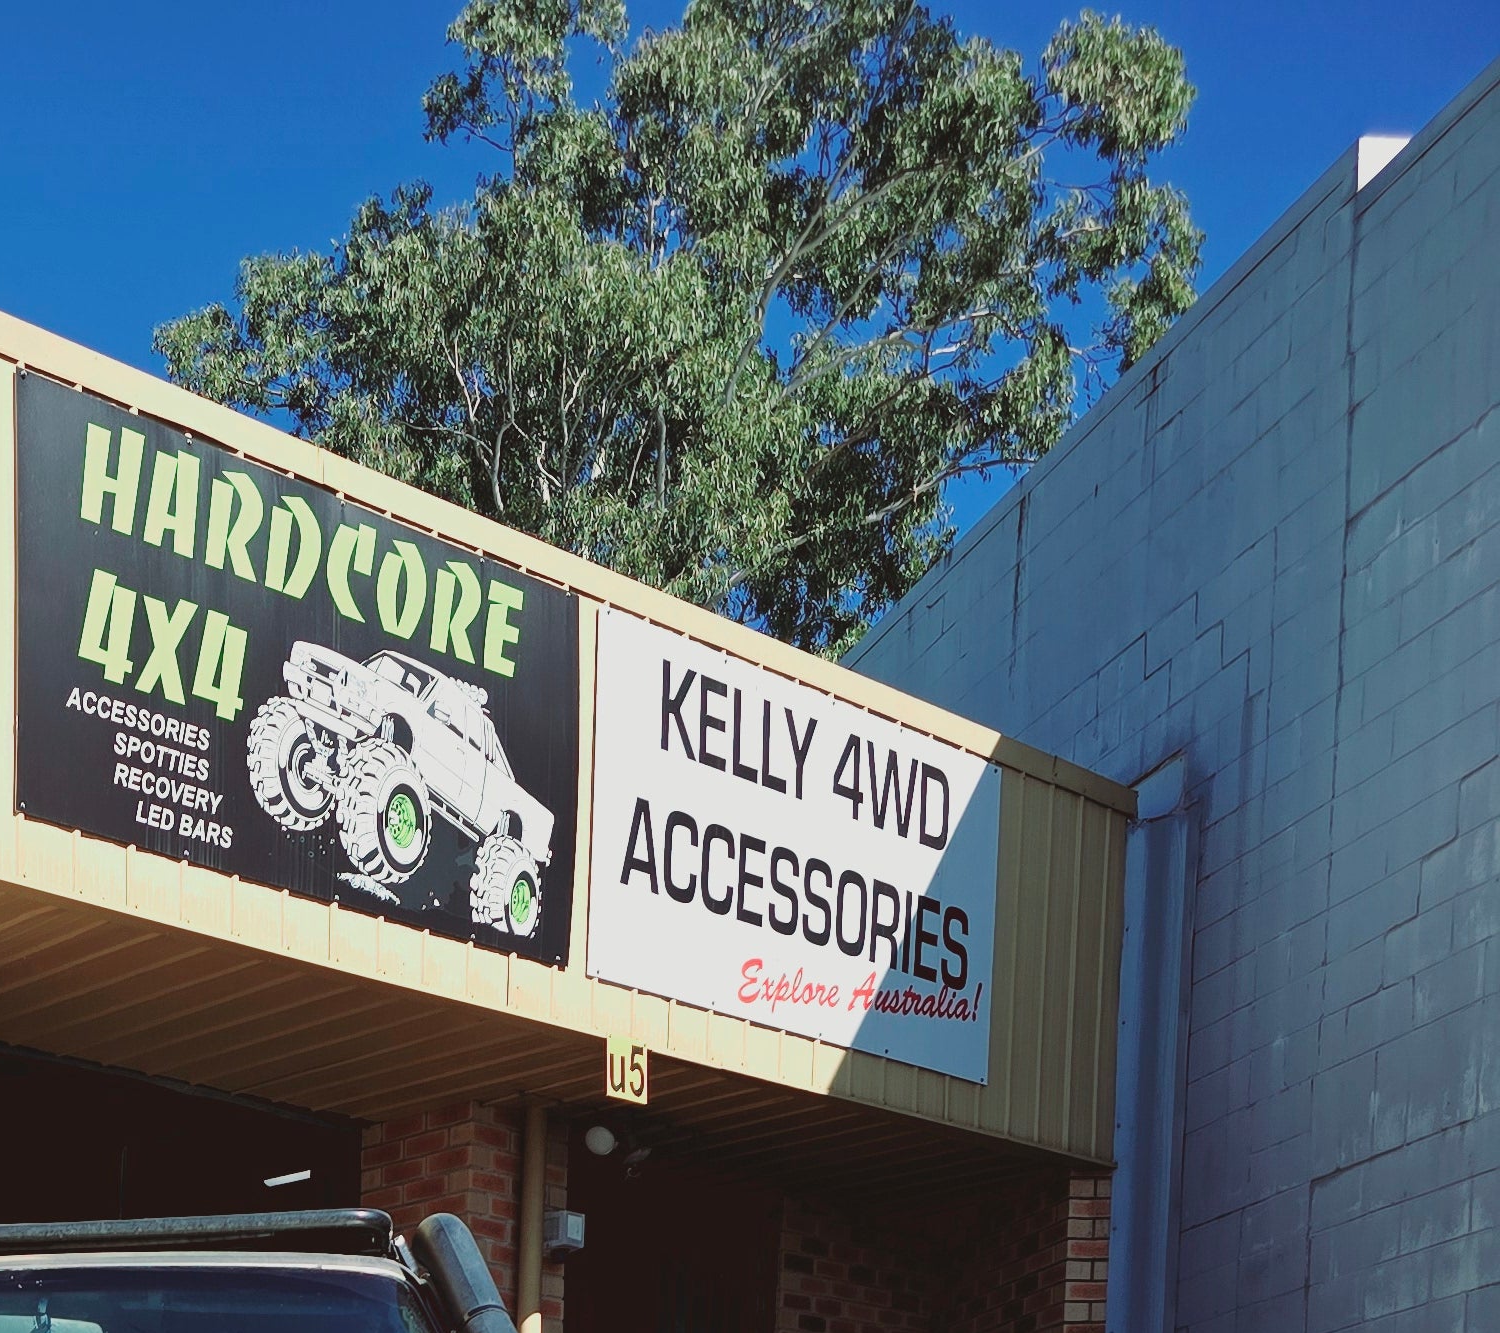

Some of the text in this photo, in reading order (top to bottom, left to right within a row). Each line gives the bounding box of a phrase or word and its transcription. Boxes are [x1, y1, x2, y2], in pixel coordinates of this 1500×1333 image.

[80, 422, 524, 678] HARDCORE
[77, 568, 248, 722] 4X4
[65, 687, 211, 751] ACCESSORIES
[113, 732, 210, 781] SPOTTIES
[660, 659, 950, 851] KELLY 4WD
[113, 762, 224, 815] RECOVERY
[135, 801, 234, 848] LED BARS
[619, 796, 969, 991] ACCESSORIES
[737, 958, 983, 1022] Explore Australia!
